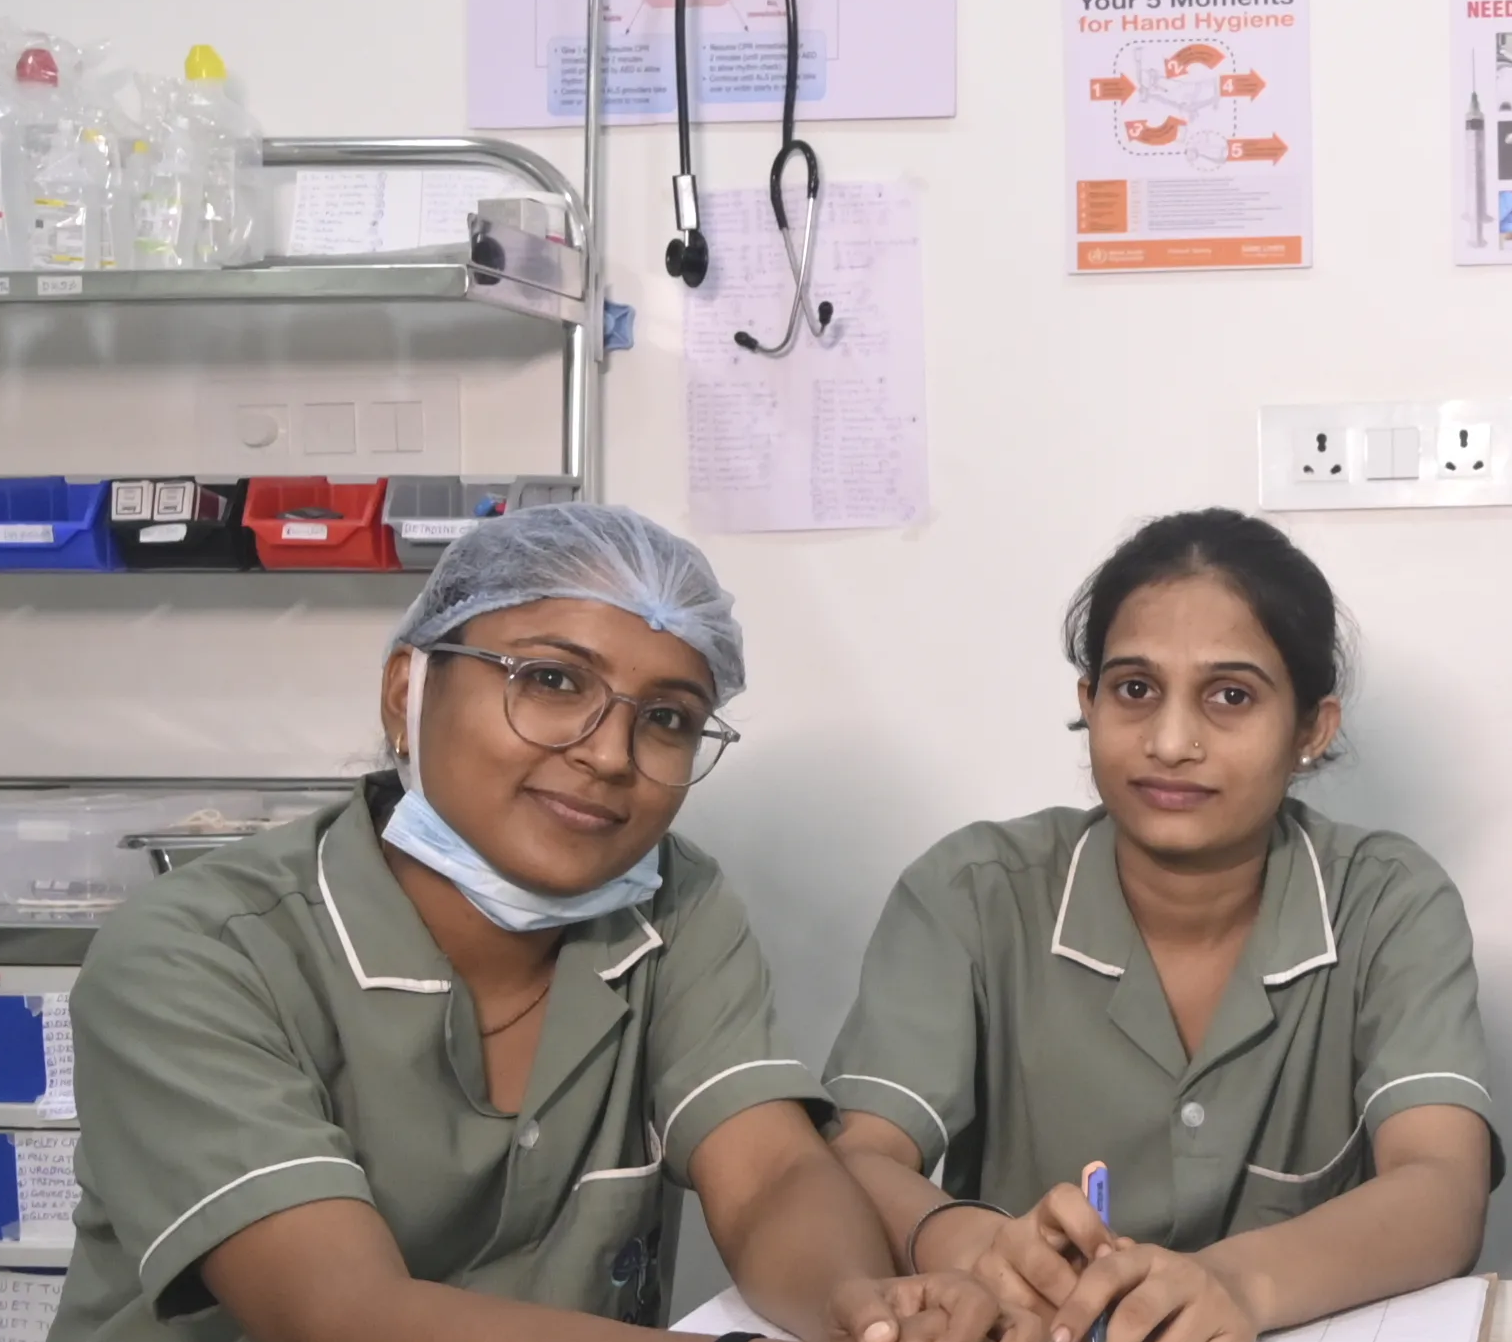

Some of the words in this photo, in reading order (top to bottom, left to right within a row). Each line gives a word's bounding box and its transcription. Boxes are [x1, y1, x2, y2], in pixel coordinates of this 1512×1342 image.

[1079, 16, 1113, 32] for
[1121, 14, 1186, 32] Hand
[1195, 12, 1294, 33] Hygiene
[1167, 60, 1183, 75] 2
[1092, 83, 1101, 96] 1
[1222, 79, 1234, 92] 4
[1129, 123, 1144, 137] 3
[1231, 143, 1243, 158] 5
